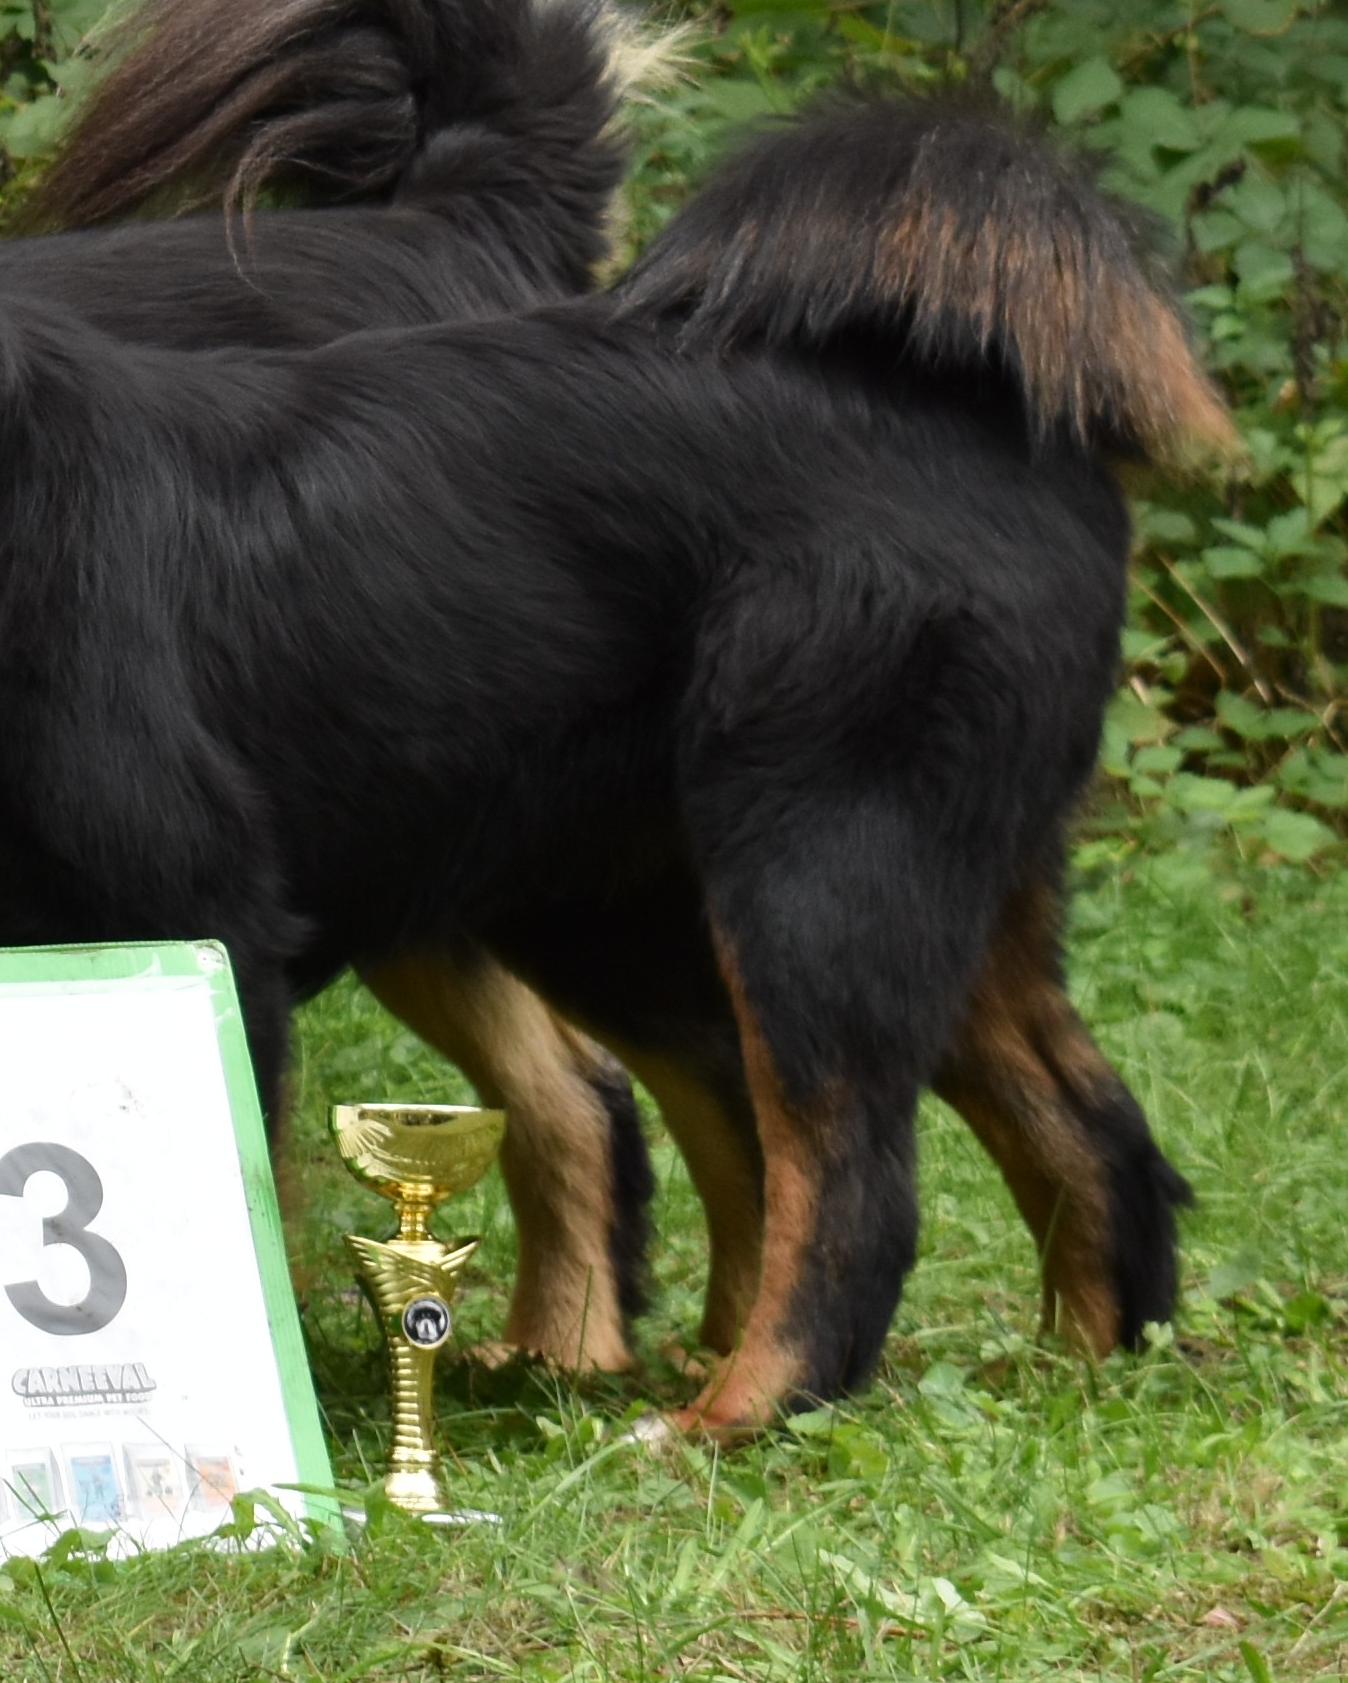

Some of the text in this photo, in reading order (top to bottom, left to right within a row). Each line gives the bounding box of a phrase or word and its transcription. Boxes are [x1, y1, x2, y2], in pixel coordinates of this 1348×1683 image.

[11, 1362, 157, 1397] CARNEEVAL
[23, 1395, 54, 1406] ULTRA
[56, 1393, 104, 1405] PREMIUM
[106, 1392, 123, 1403] PET
